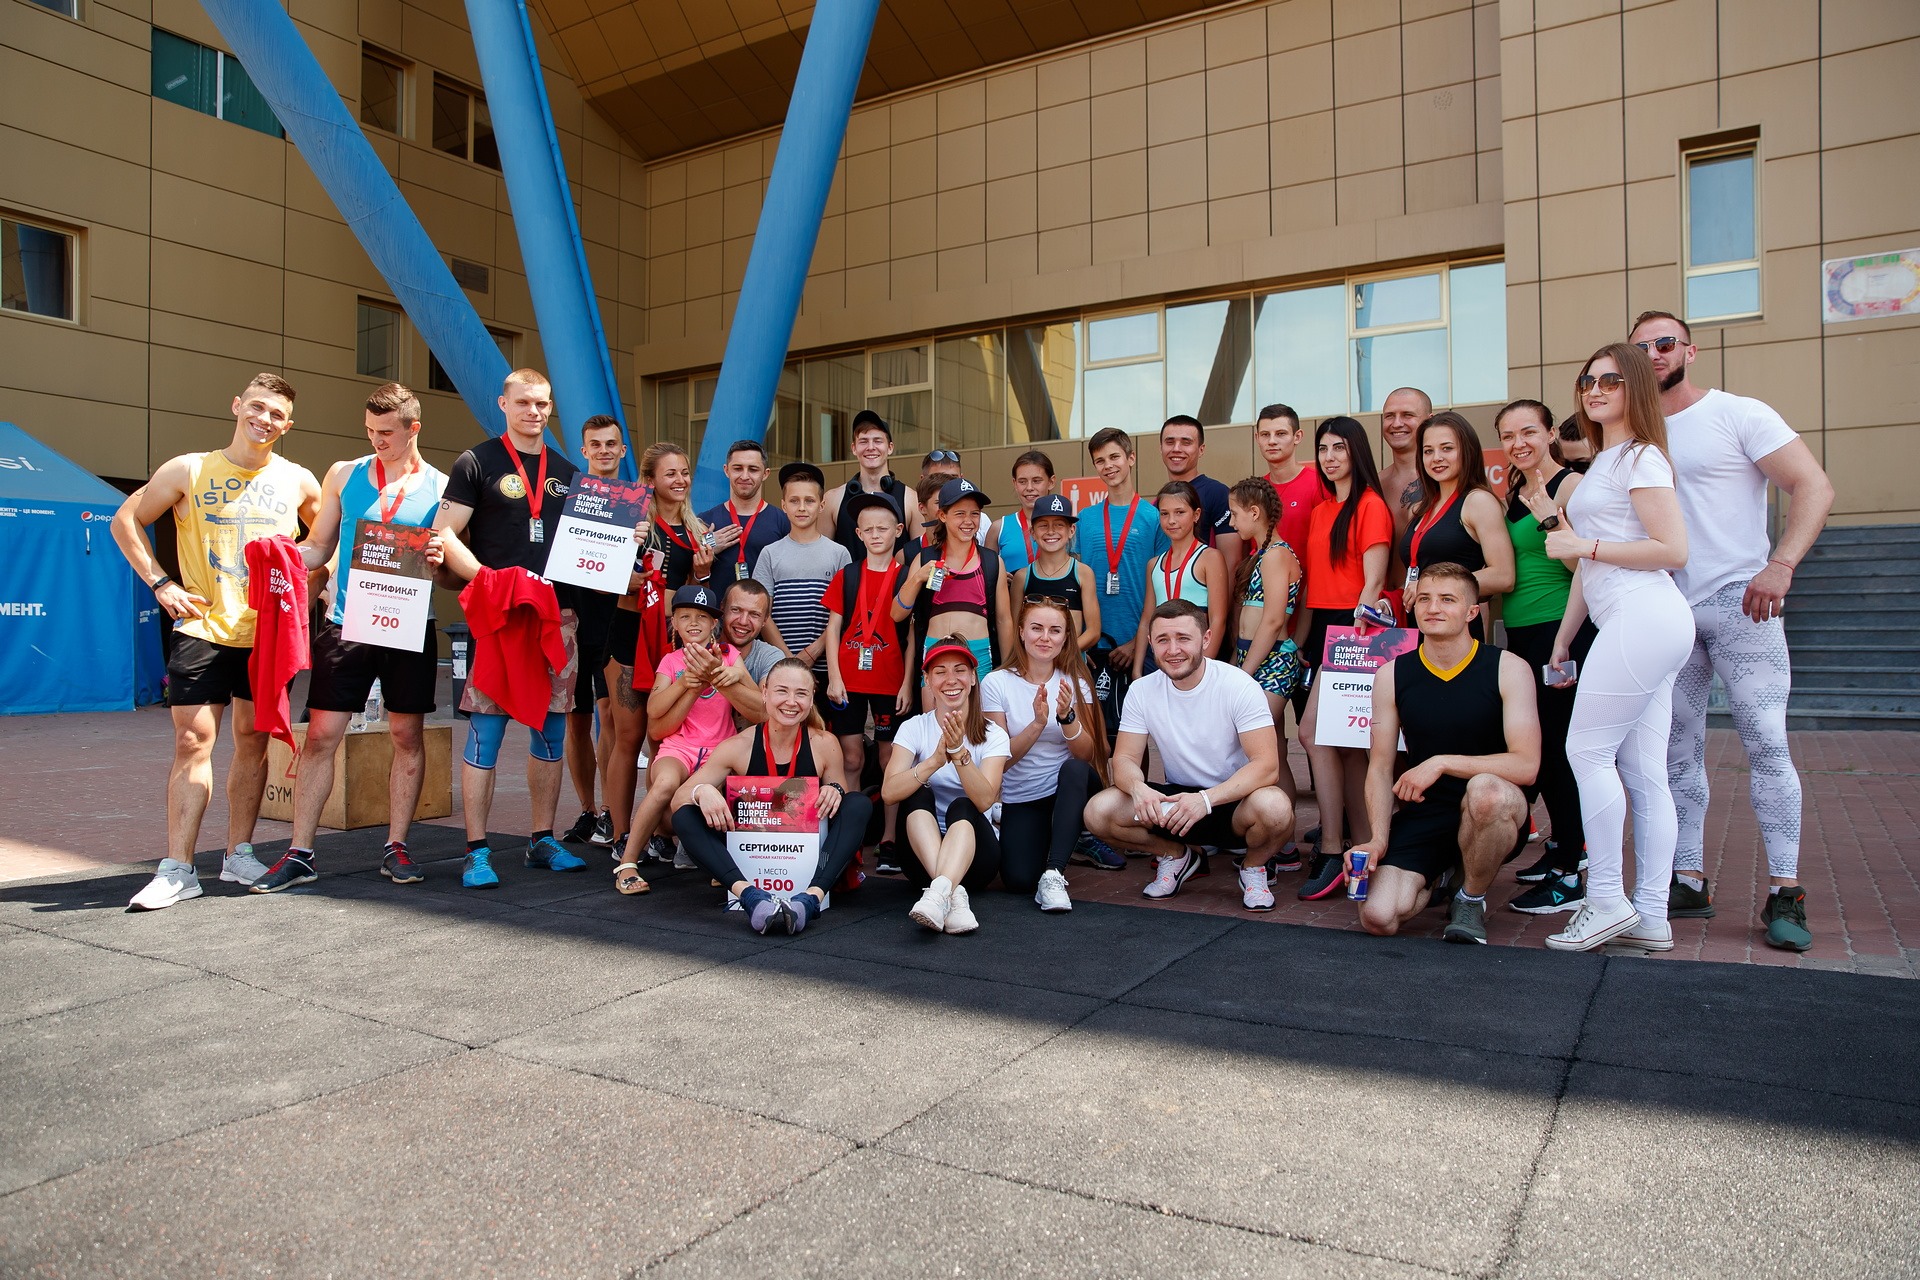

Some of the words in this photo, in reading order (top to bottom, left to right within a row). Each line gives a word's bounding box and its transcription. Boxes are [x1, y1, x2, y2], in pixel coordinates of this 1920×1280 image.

[1485, 464, 1504, 484] C
[210, 478, 275, 496] LONG
[194, 491, 288, 515] ISLAND
[576, 500, 603, 510] BURPEE
[577, 494, 608, 505] GYM4FIT
[574, 506, 614, 518] CHALLENGE
[568, 526, 628, 544] СЕРТИФИКАТ
[364, 543, 395, 554] GYM4FIT
[362, 550, 390, 560] BURPEE
[586, 550, 608, 560] МЕСТО
[362, 557, 402, 569] CHALLENGE
[576, 558, 606, 572] 300
[360, 581, 418, 596] СЕРТИФИКАТ
[379, 606, 400, 614] МЕСТО
[372, 614, 400, 629] 700
[1335, 646, 1370, 654] GYM4FIT
[1334, 652, 1365, 660] BURPEE
[1332, 682, 1372, 692] СЕРТИФ
[266, 784, 292, 804] GYM
[738, 801, 772, 810] GYM4FIT
[739, 844, 804, 852] СЕРТИФИКАТ
[754, 878, 794, 892] 1500
